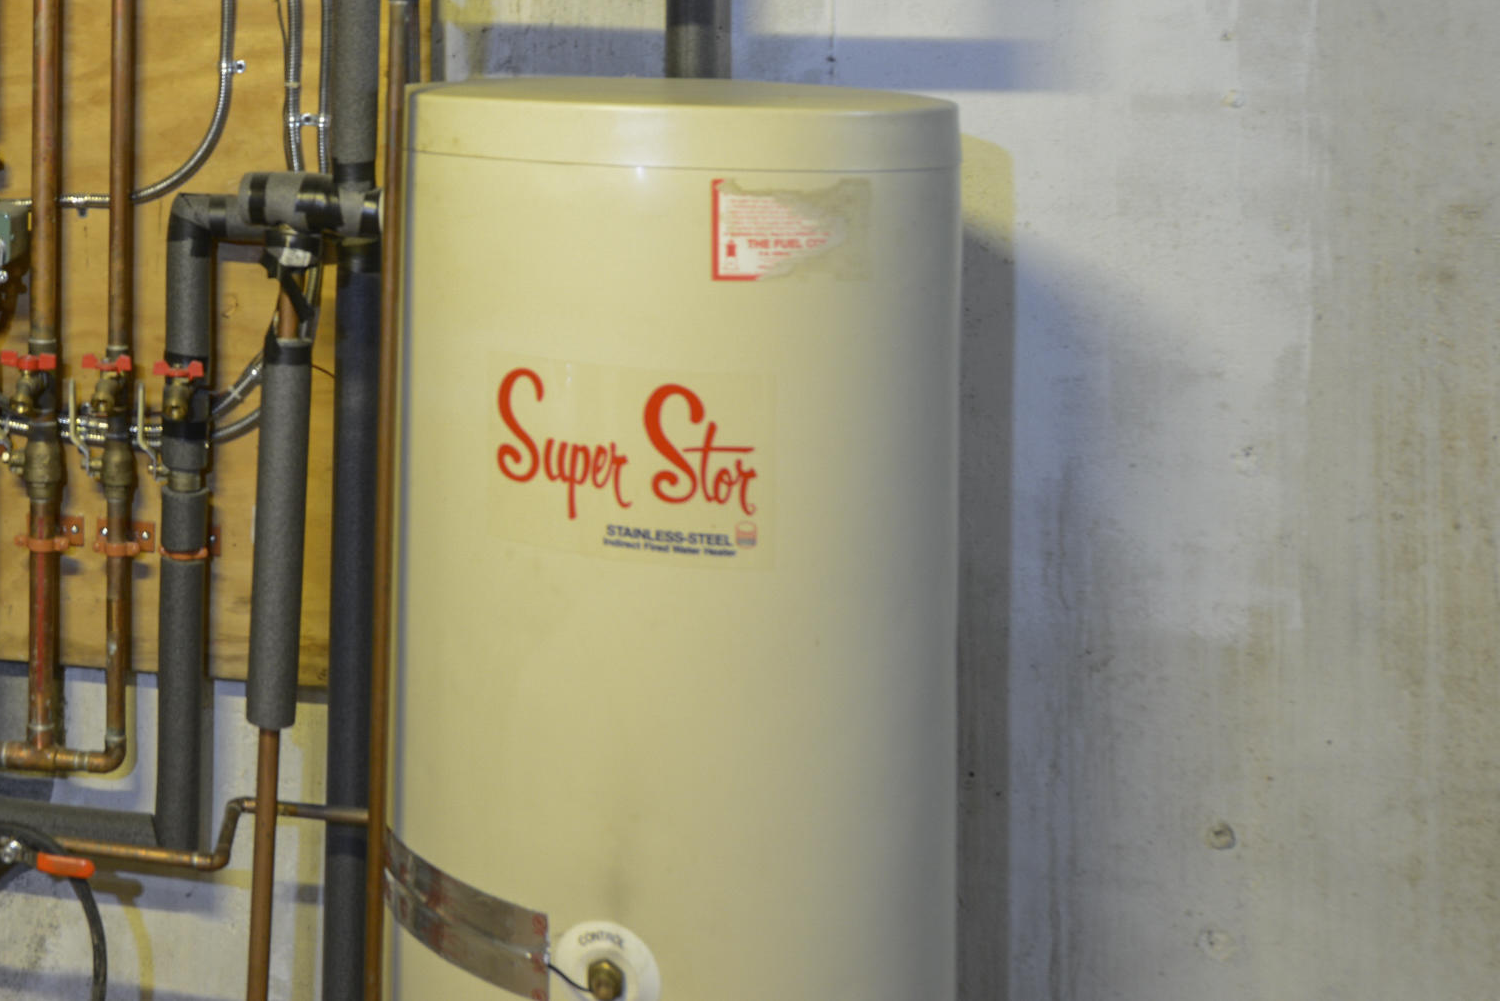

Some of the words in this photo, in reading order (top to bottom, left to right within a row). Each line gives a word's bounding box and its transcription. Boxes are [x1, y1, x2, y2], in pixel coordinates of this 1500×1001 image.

[748, 238, 770, 249] THE
[773, 238, 803, 249] FUEL
[497, 368, 633, 520] Super
[643, 383, 758, 516] Stor
[606, 524, 734, 547] STAINLESS-STEEL
[602, 537, 641, 550] Indirect
[643, 542, 671, 554] Fired
[672, 545, 702, 555] Water
[578, 930, 625, 948] CONTROL
